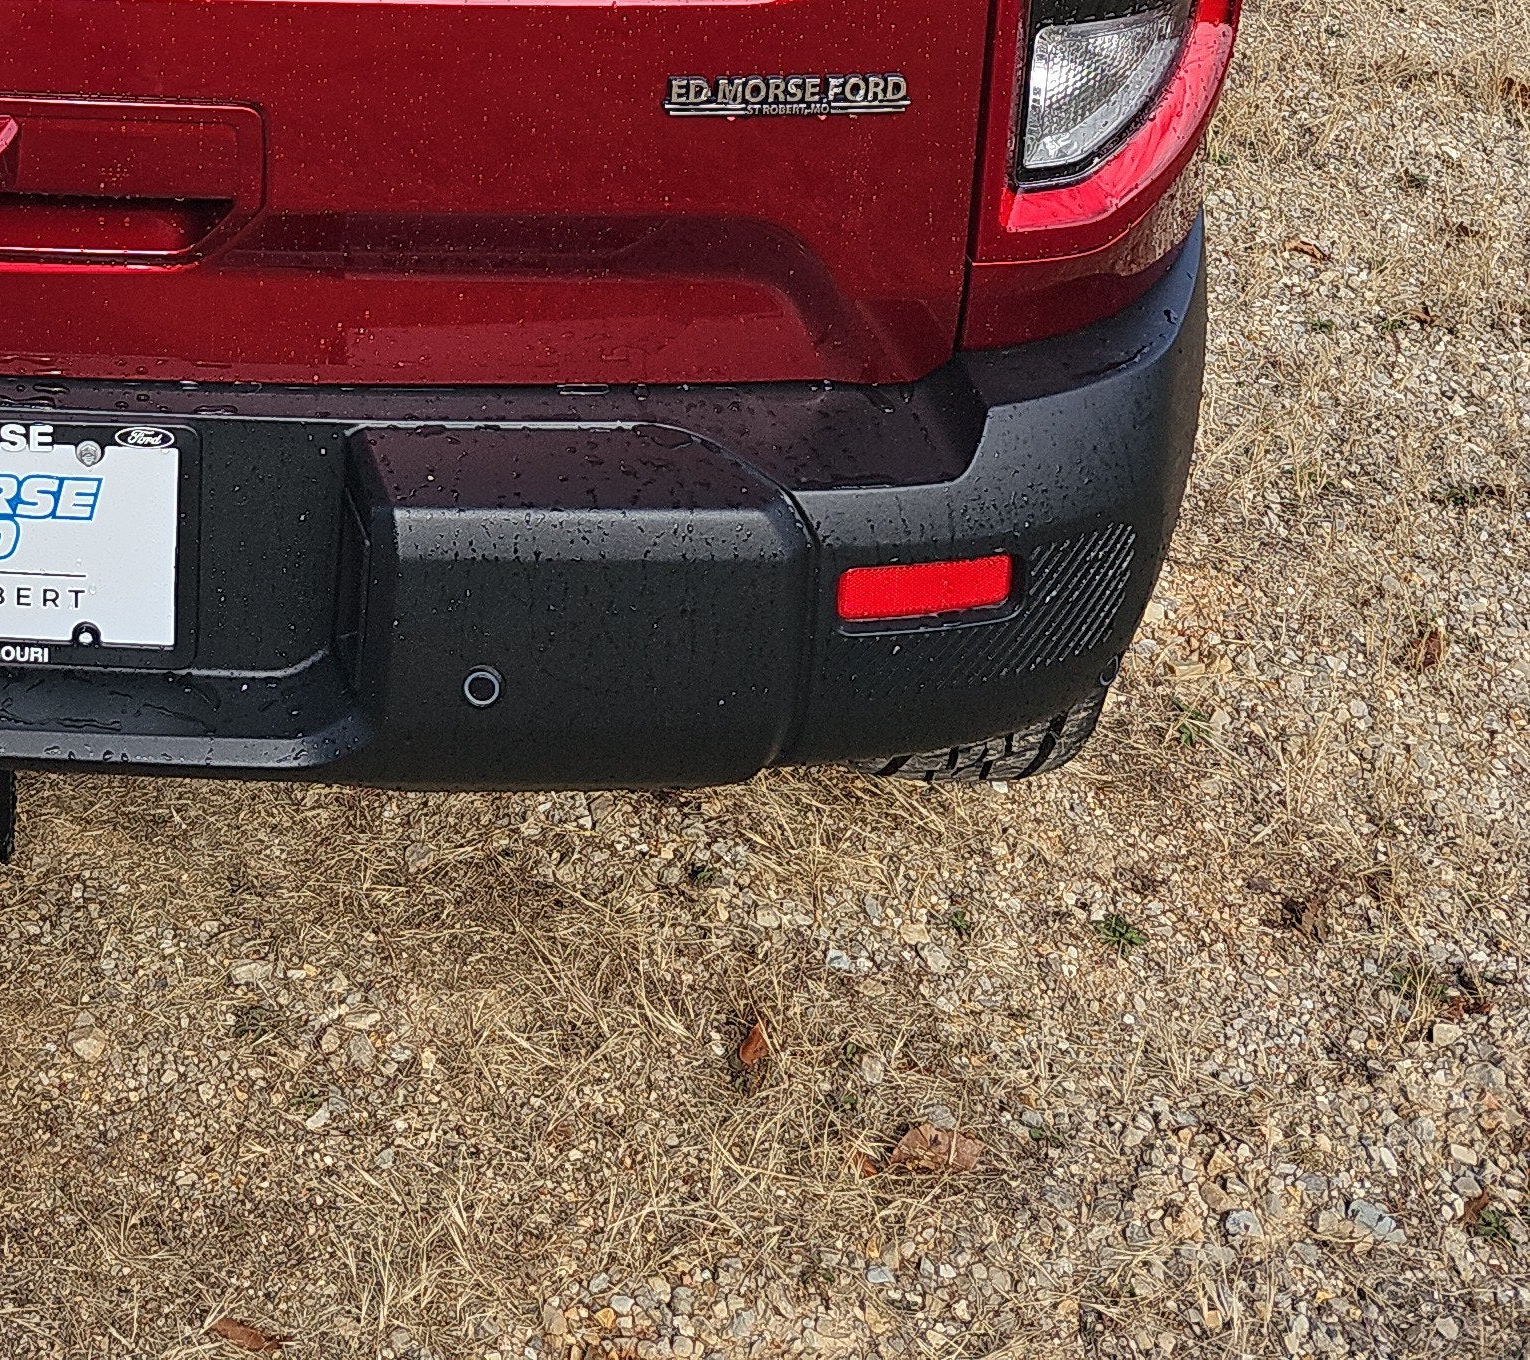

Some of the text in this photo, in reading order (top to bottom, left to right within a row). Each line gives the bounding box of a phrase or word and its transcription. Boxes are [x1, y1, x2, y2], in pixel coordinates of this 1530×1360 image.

[670, 75, 907, 103] ED MORSE FORD
[127, 430, 163, 445] Ford
